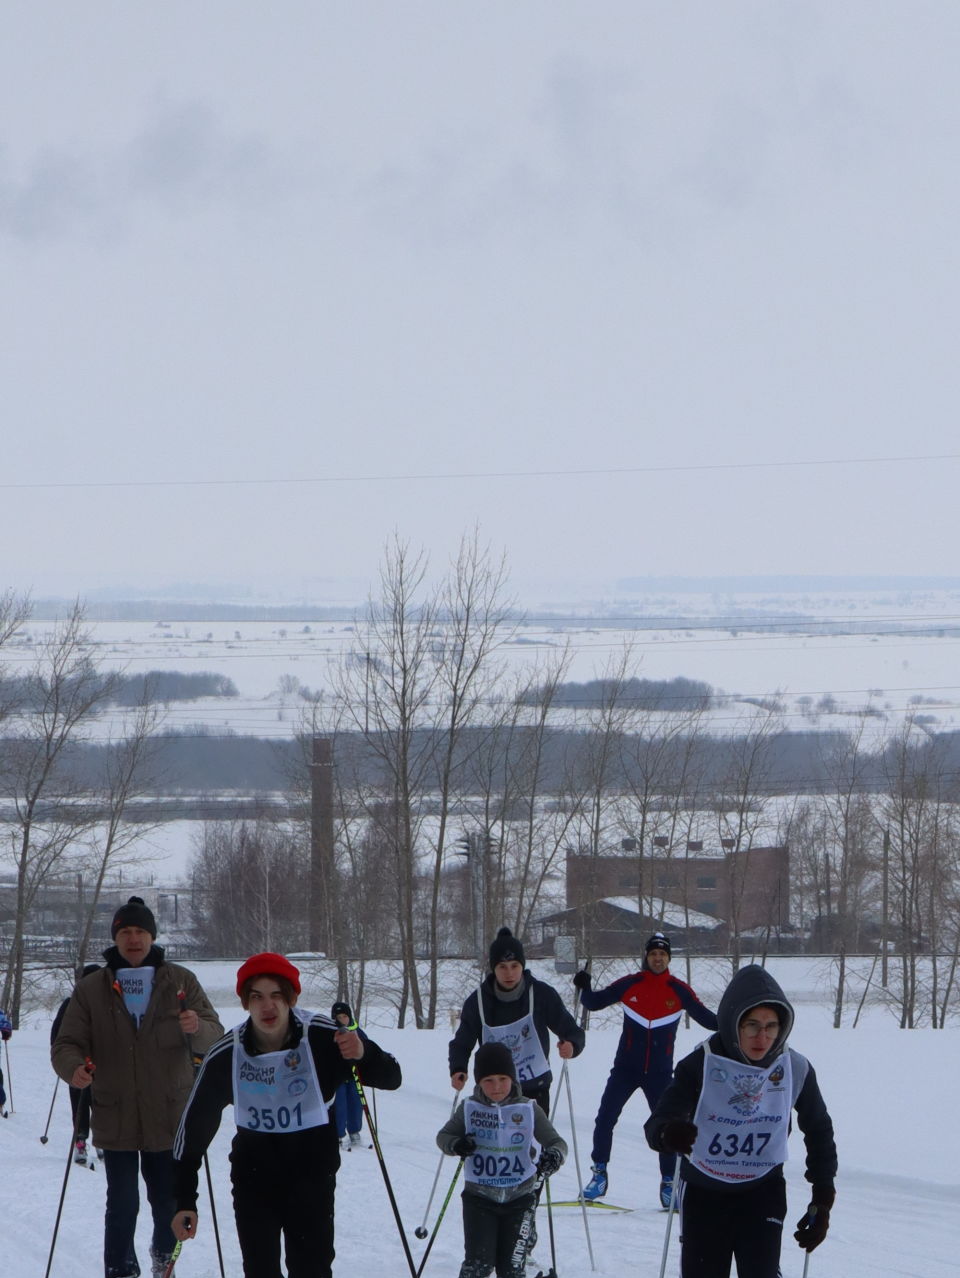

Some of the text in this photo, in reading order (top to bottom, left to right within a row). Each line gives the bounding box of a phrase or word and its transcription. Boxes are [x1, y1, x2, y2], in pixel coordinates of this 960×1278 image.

[247, 1102, 303, 1130] 3501
[708, 1132, 771, 1157] 6347
[473, 1153, 525, 1177] 9024
